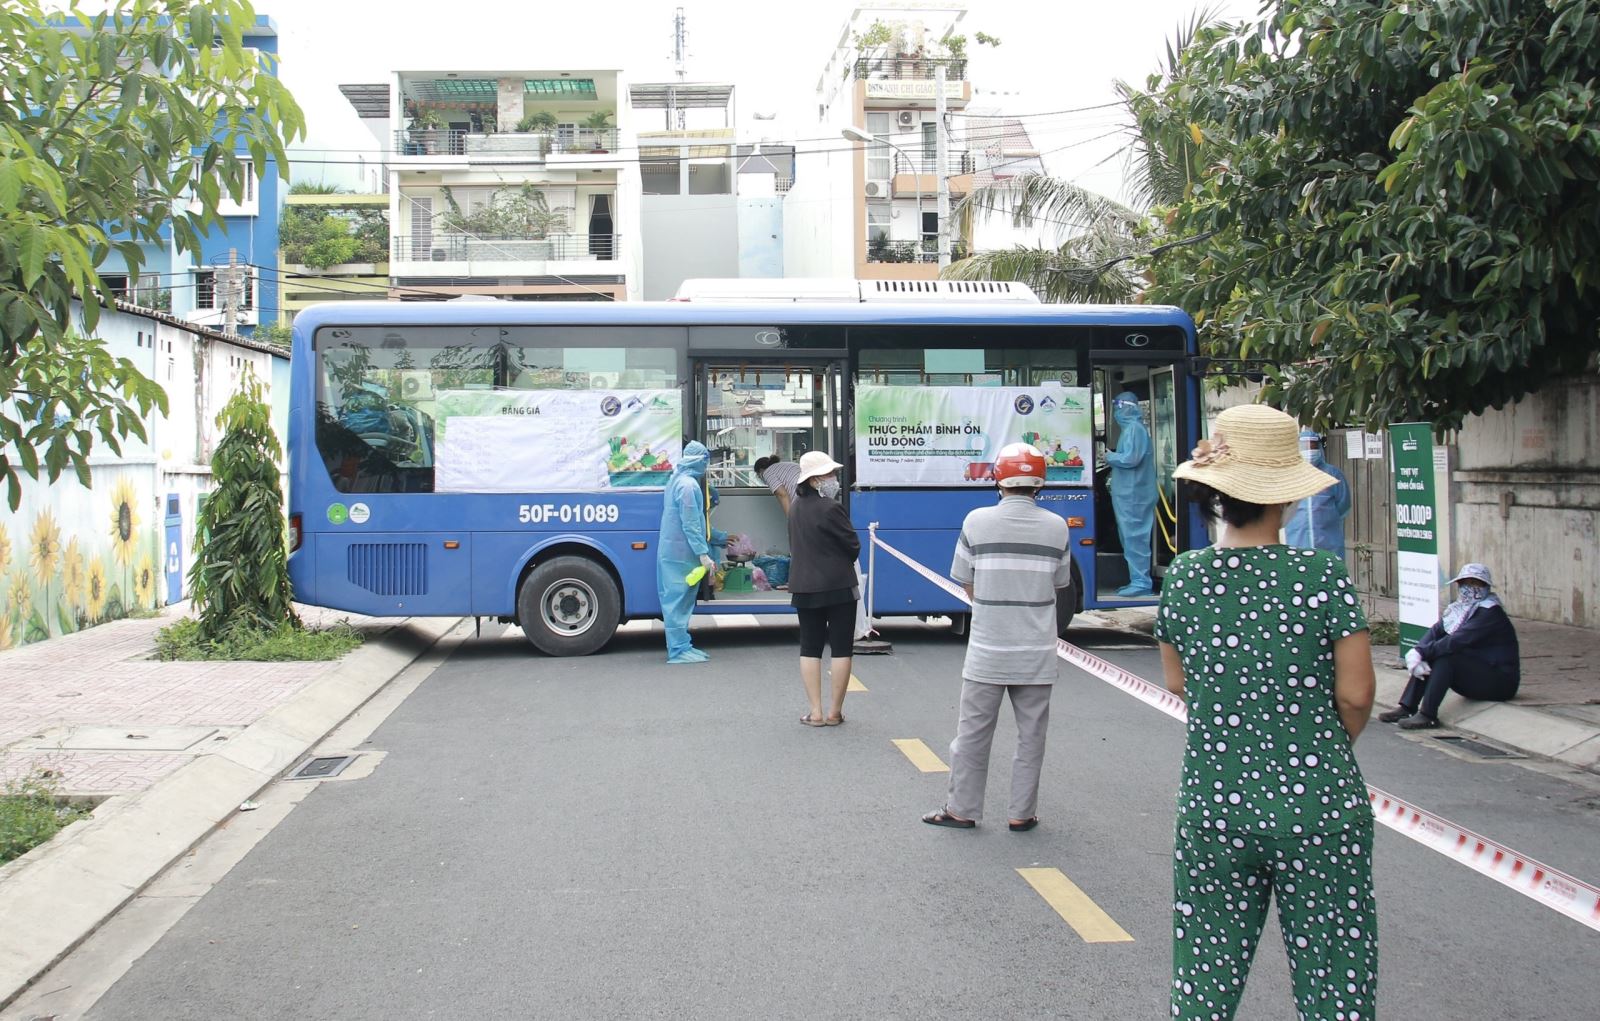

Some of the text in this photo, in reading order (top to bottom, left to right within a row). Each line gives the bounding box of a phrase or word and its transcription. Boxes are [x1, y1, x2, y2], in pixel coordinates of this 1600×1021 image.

[502, 404, 525, 415] BẢNG
[526, 404, 541, 415] GIÁ
[868, 415, 907, 424] Chương trình
[868, 420, 981, 437] THỰC PHẨM BÌNH ỔN
[869, 436, 925, 448] LƯU ĐỘNG
[519, 504, 619, 523] 50F-01089
